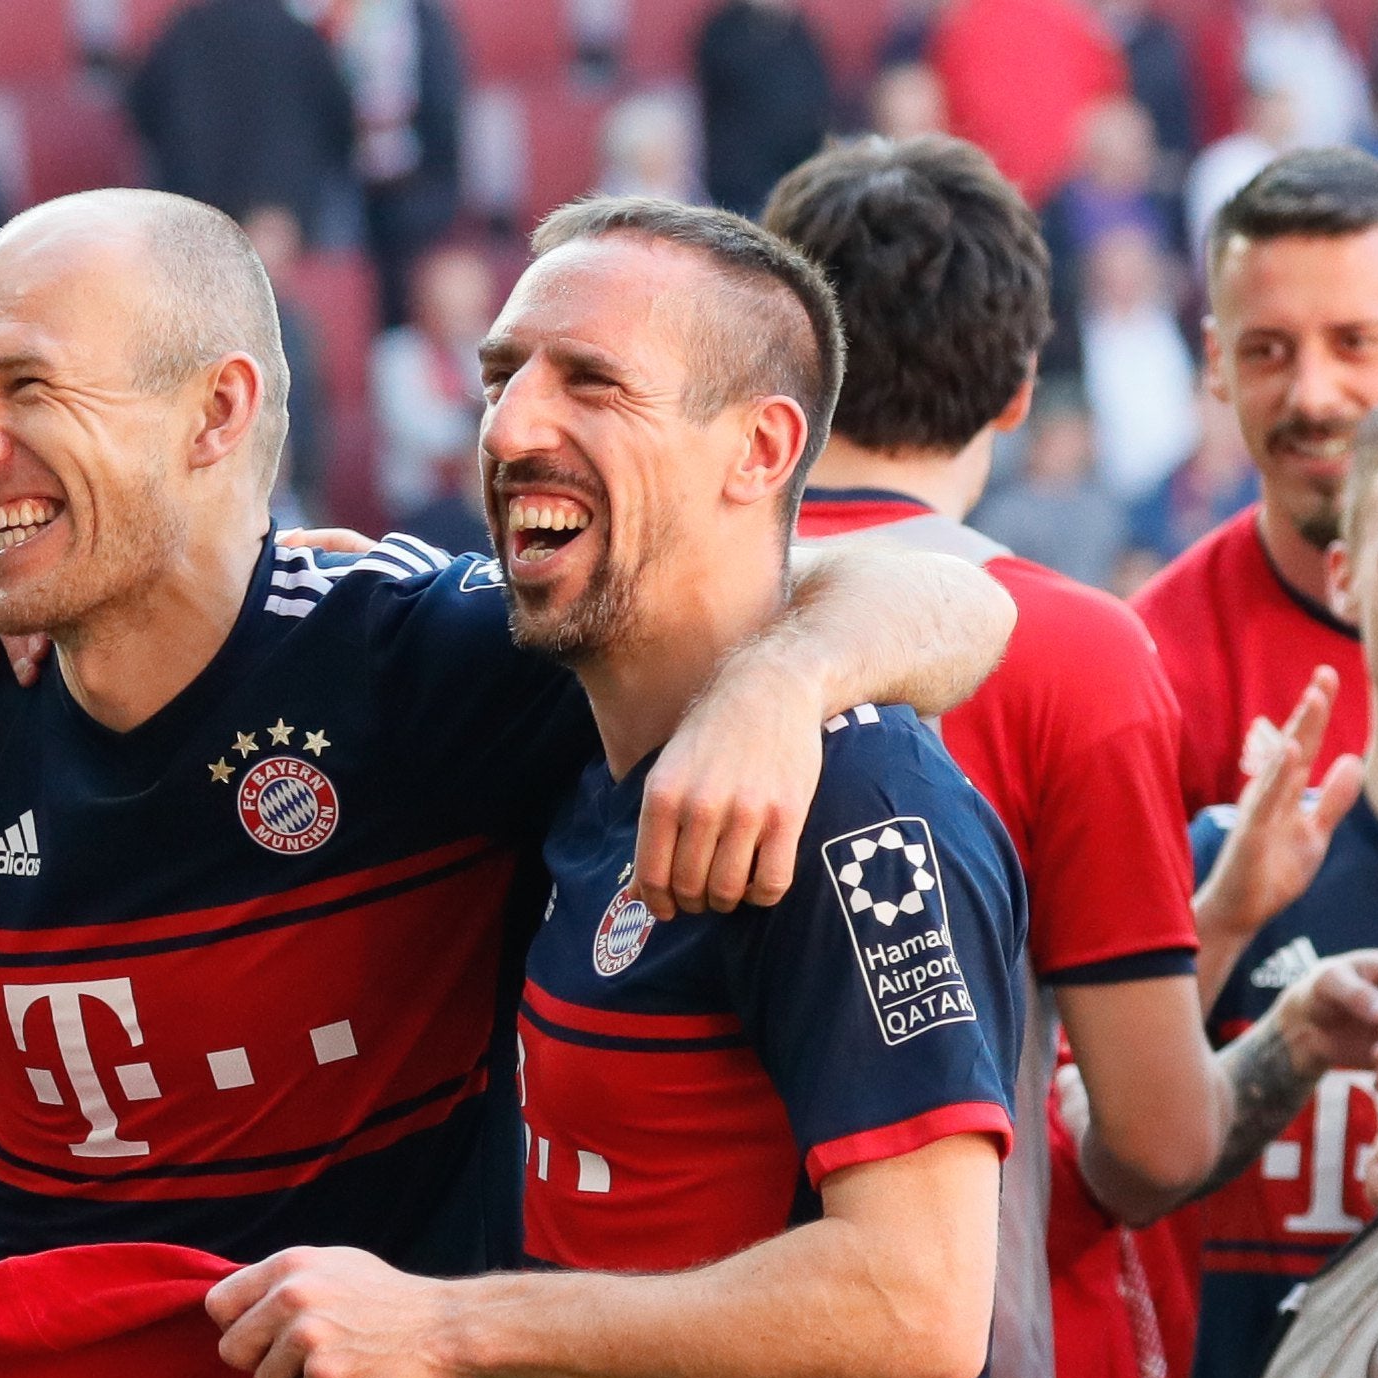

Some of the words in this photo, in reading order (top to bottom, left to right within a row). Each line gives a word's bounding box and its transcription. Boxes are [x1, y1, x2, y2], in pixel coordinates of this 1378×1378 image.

[243, 788, 257, 811] FC
[252, 762, 325, 792] BAYERN
[254, 805, 334, 850] MÜNCHEN
[878, 953, 960, 999] Airport
[887, 989, 974, 1036] QATAR
[3, 977, 151, 1158] T
